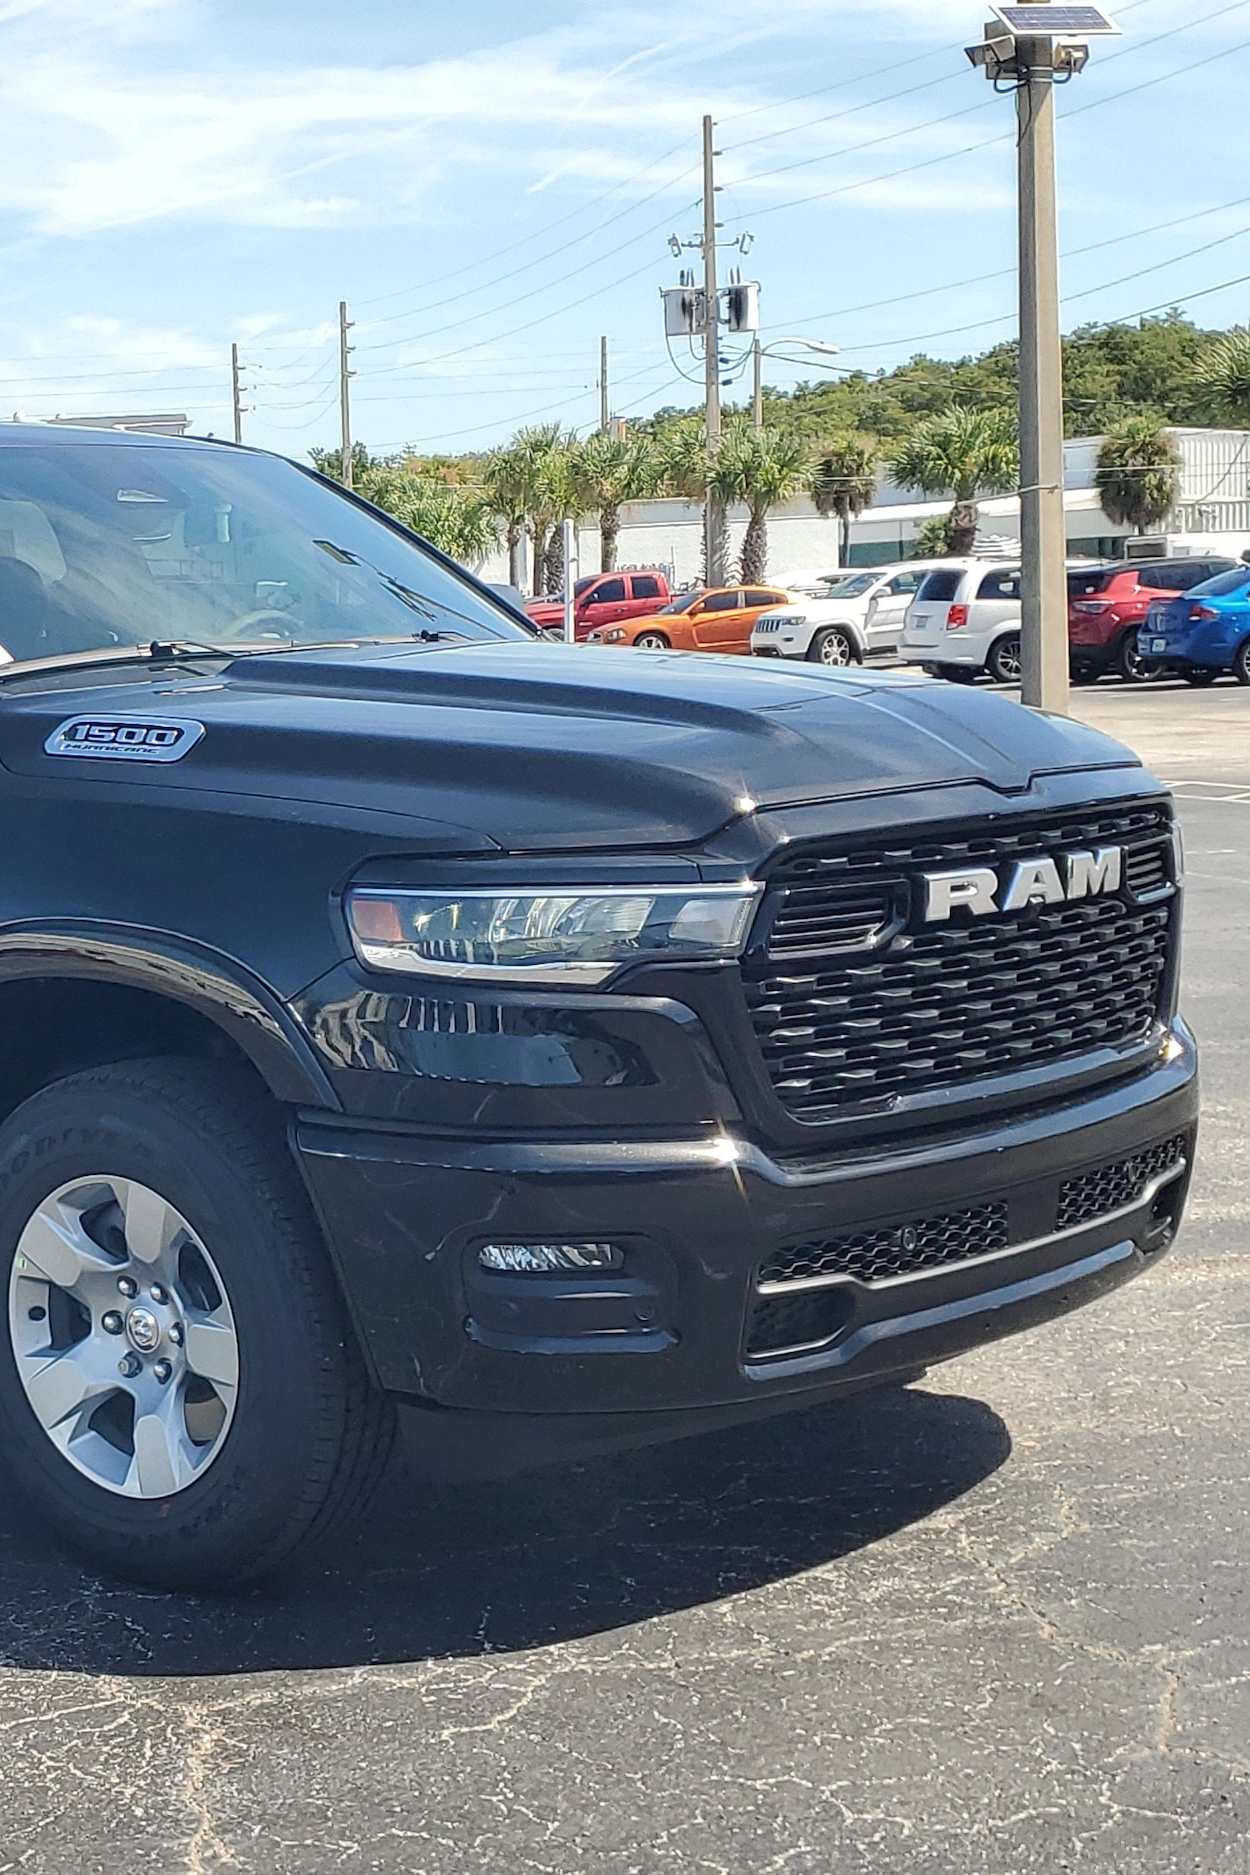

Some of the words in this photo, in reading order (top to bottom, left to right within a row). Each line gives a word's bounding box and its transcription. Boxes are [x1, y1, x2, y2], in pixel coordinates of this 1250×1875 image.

[75, 724, 179, 746] 1500
[64, 743, 160, 754] HURRICANE
[923, 844, 1123, 922] RAM
